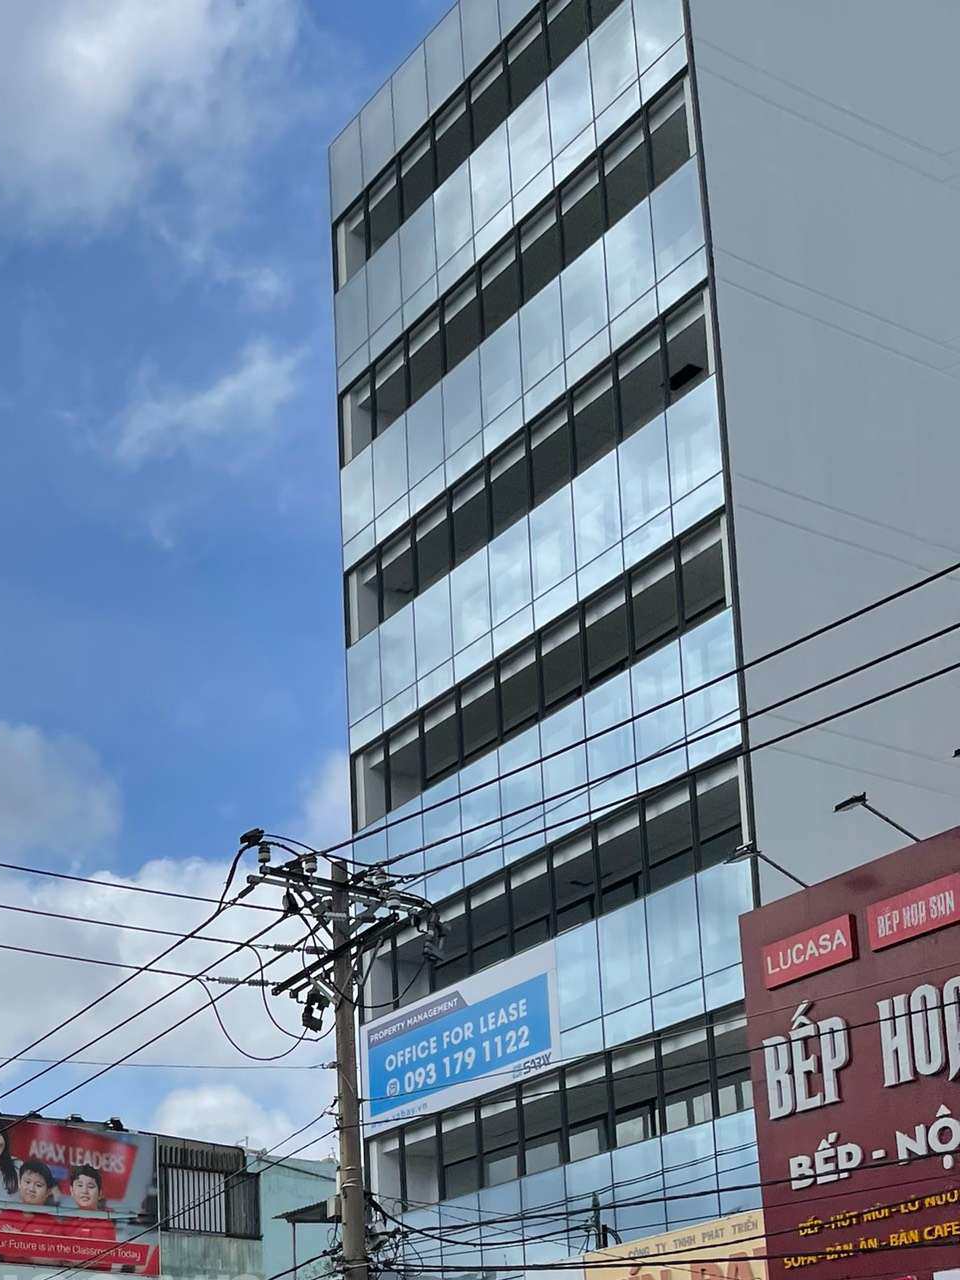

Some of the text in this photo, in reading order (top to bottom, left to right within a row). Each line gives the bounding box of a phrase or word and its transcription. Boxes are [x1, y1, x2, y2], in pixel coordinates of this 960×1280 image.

[766, 929, 847, 975] LUCASA
[369, 997, 459, 1043] PROPERTY MANAGEMENT
[384, 998, 528, 1072] OFFICE FOR LEASE
[404, 1025, 530, 1094] 093 179 1122
[761, 999, 850, 1121] BẾP
[29, 1139, 125, 1174] APAX LEADERS
[789, 1131, 863, 1191] BẾP
[8, 1239, 38, 1251] Future
[57, 1242, 71, 1254] the
[117, 1248, 141, 1262] Today
[655, 1243, 666, 1254] TY
